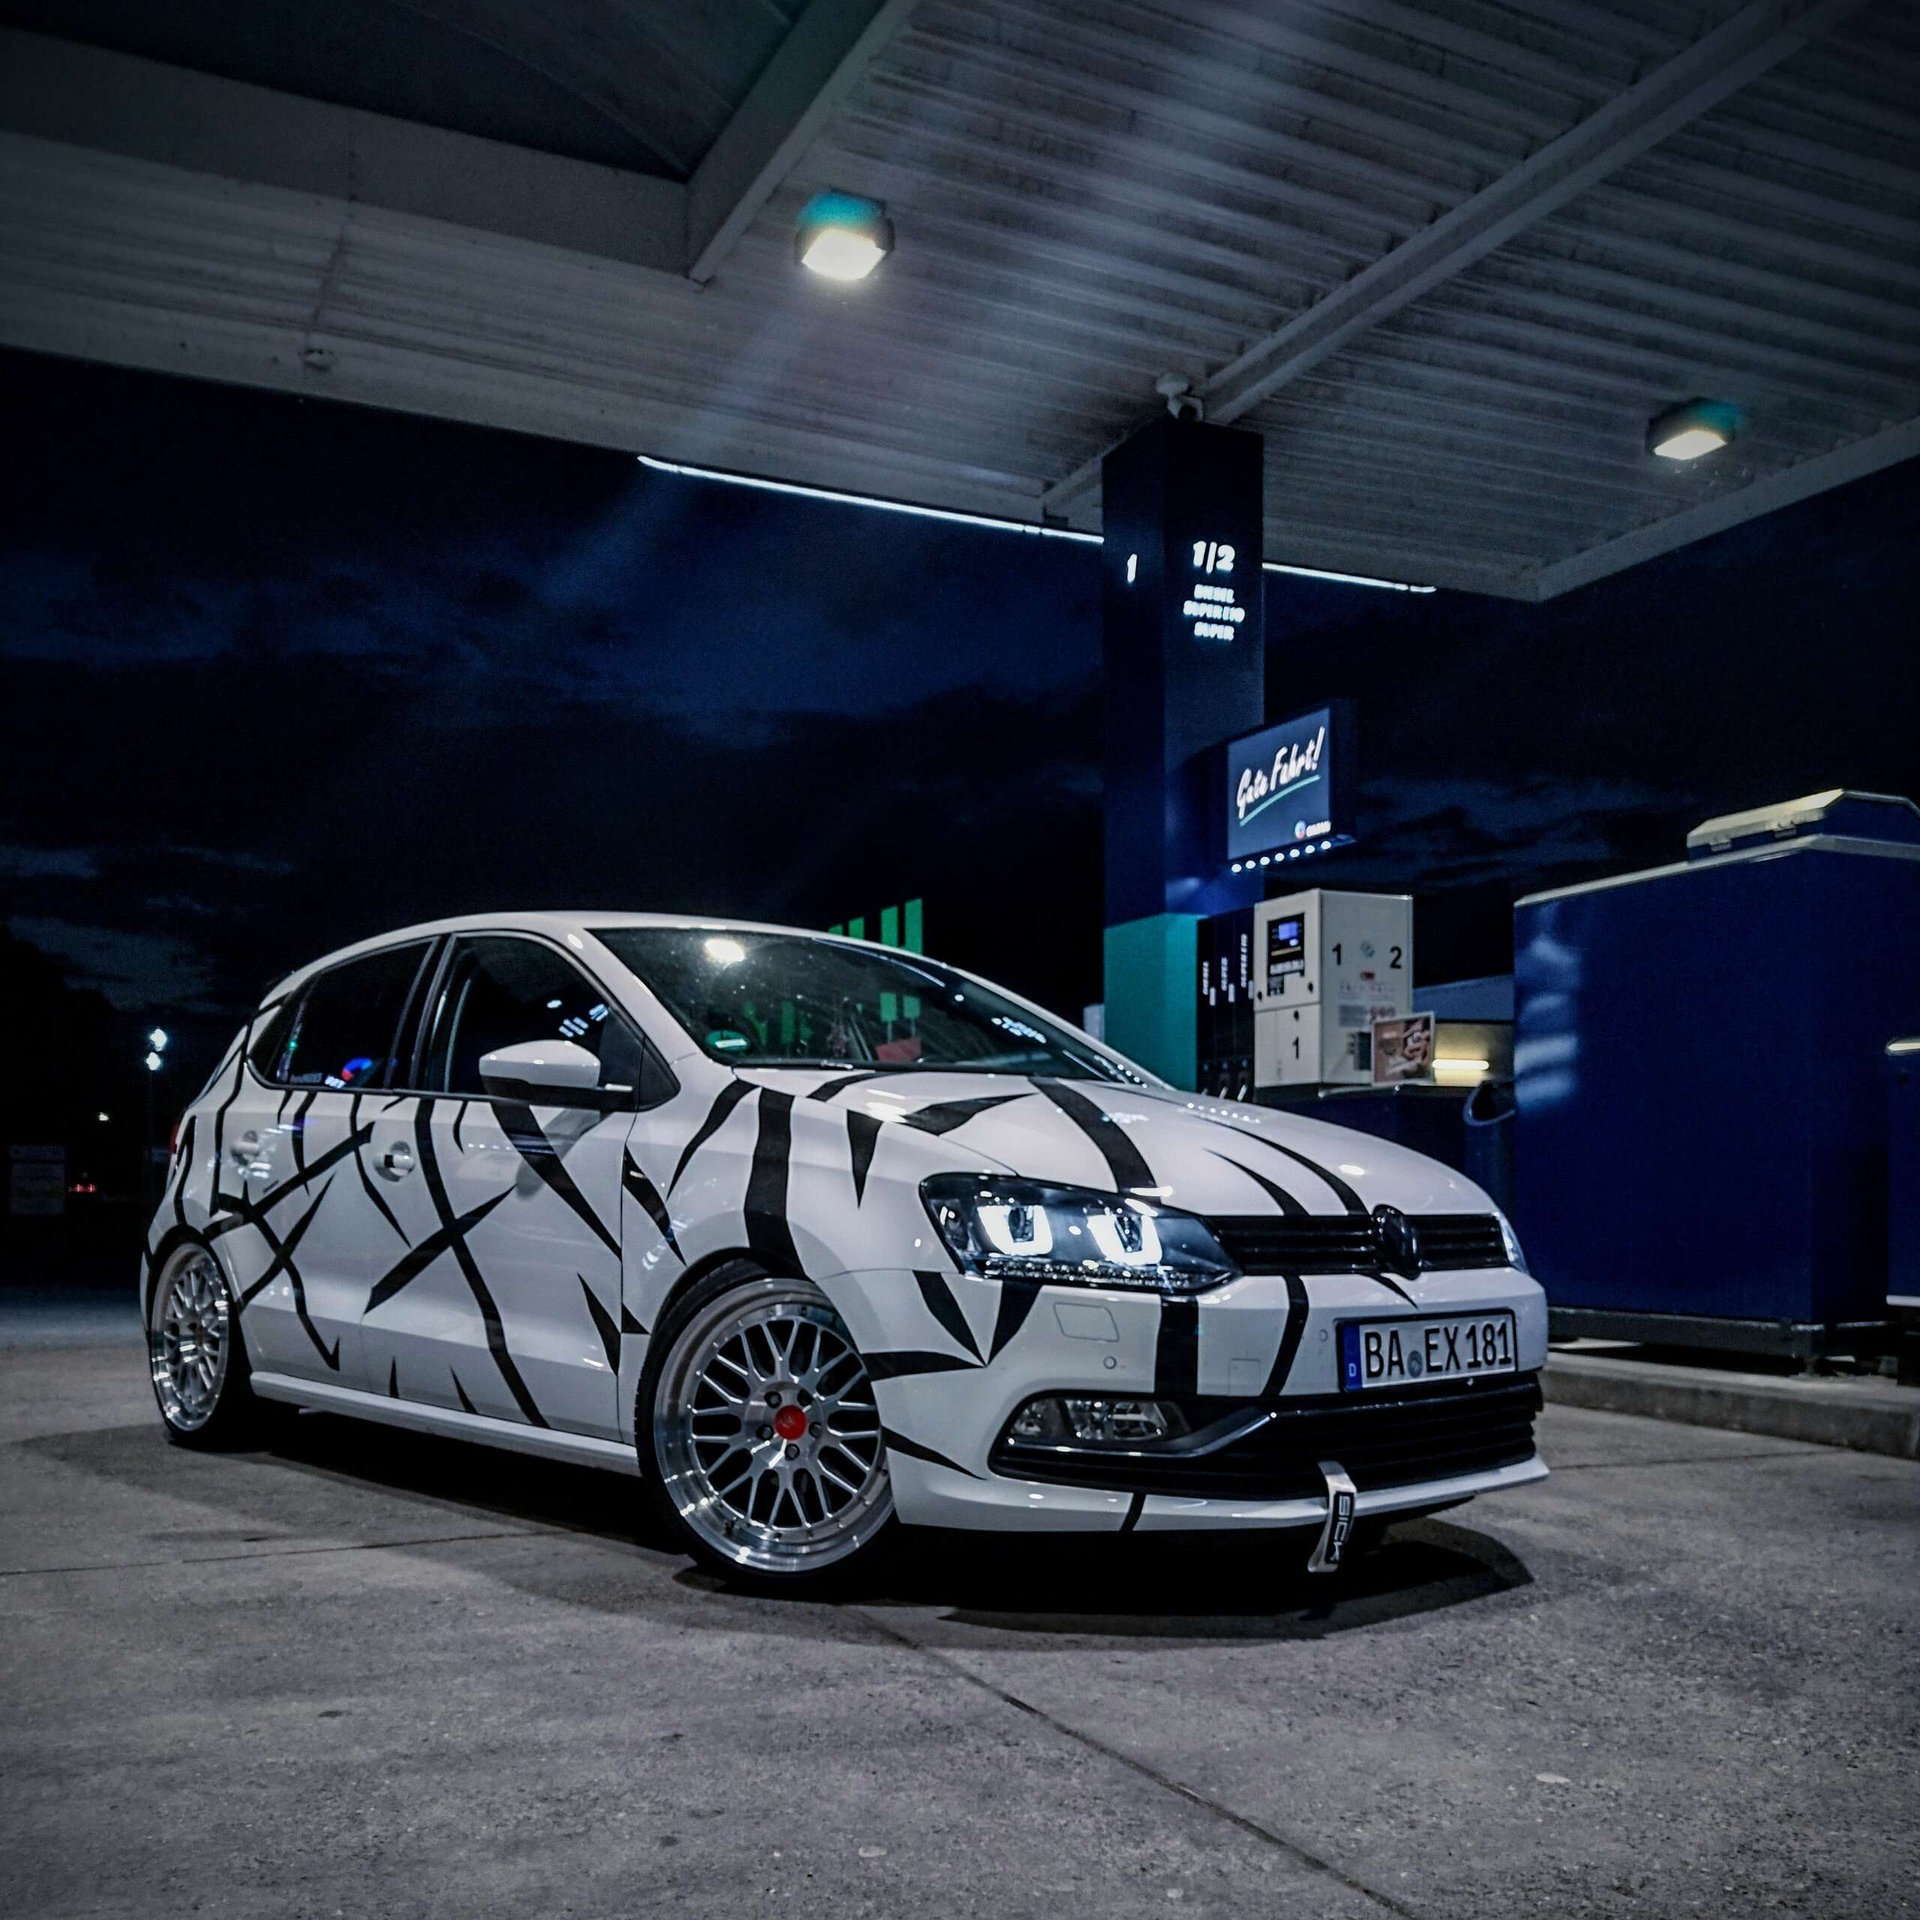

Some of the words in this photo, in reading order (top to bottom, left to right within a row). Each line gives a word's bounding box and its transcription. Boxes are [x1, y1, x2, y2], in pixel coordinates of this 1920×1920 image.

[1270, 726, 1325, 791] Fahrt!
[1332, 943, 1341, 966] 1
[1390, 946, 1402, 969] 2
[1292, 1036, 1300, 1059] 1
[1364, 1329, 1405, 1378] BA
[1425, 1325, 1461, 1373] EX
[1465, 1322, 1512, 1369] 181
[1348, 1363, 1357, 1378] D
